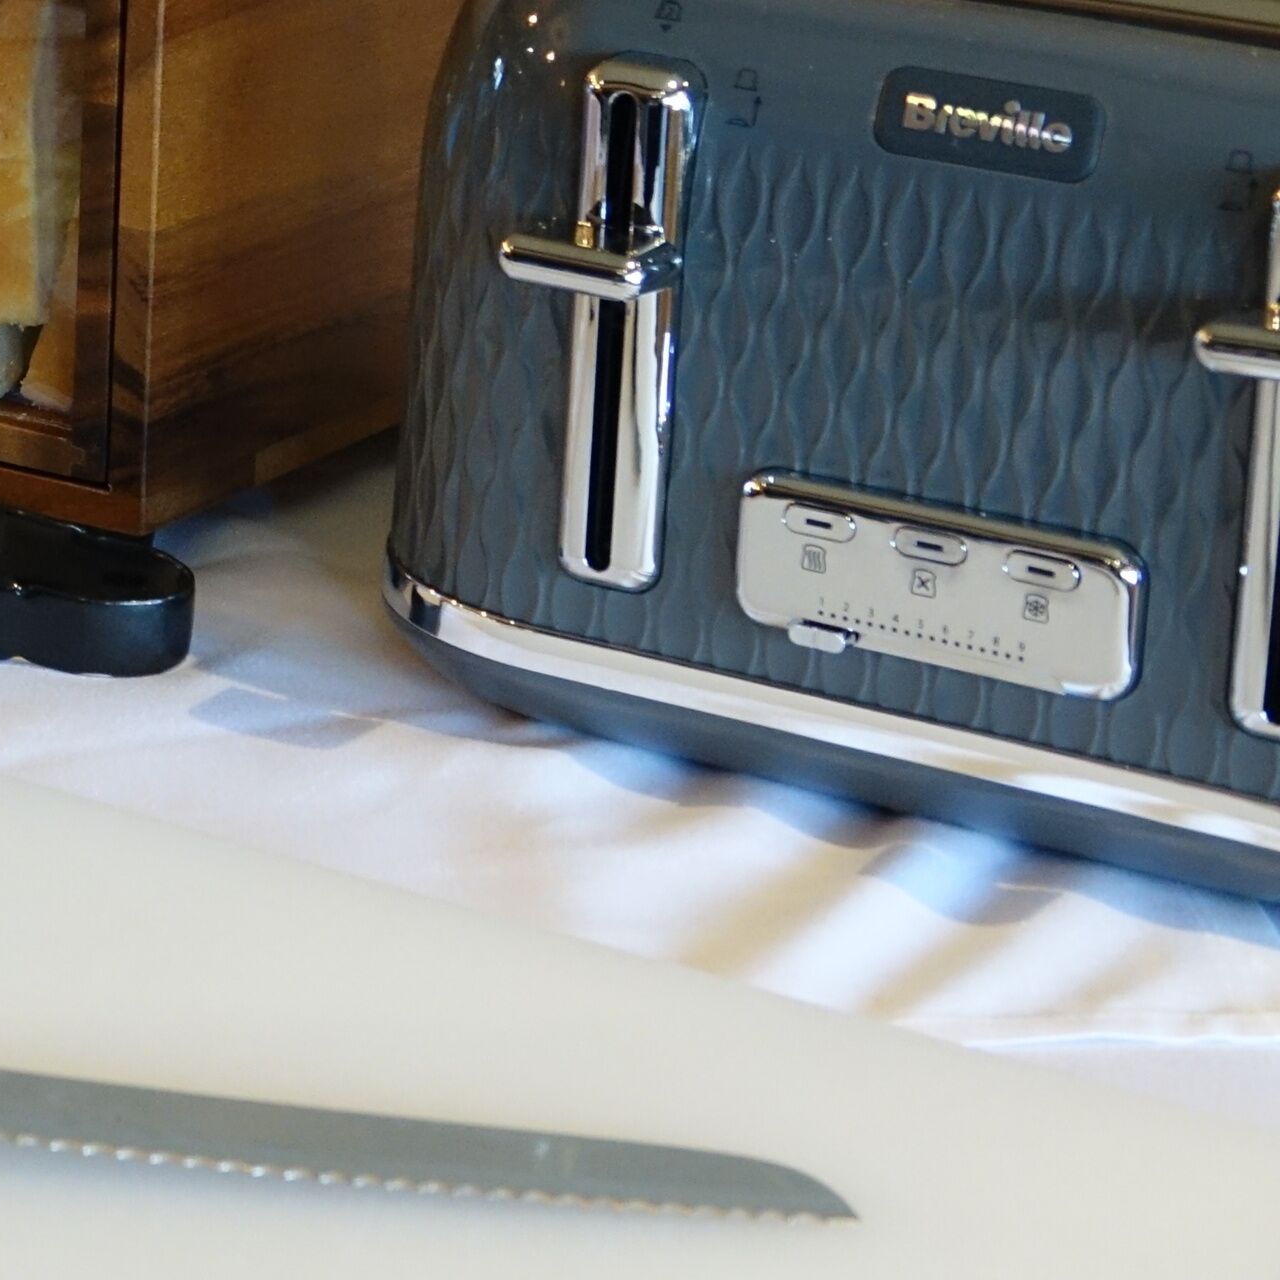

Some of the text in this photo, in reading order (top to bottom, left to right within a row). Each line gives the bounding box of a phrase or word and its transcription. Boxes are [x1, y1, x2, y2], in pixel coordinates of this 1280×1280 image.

[903, 91, 1073, 154] Breville
[819, 597, 1027, 653] 1 2 3 4 5 6 7 8 9
